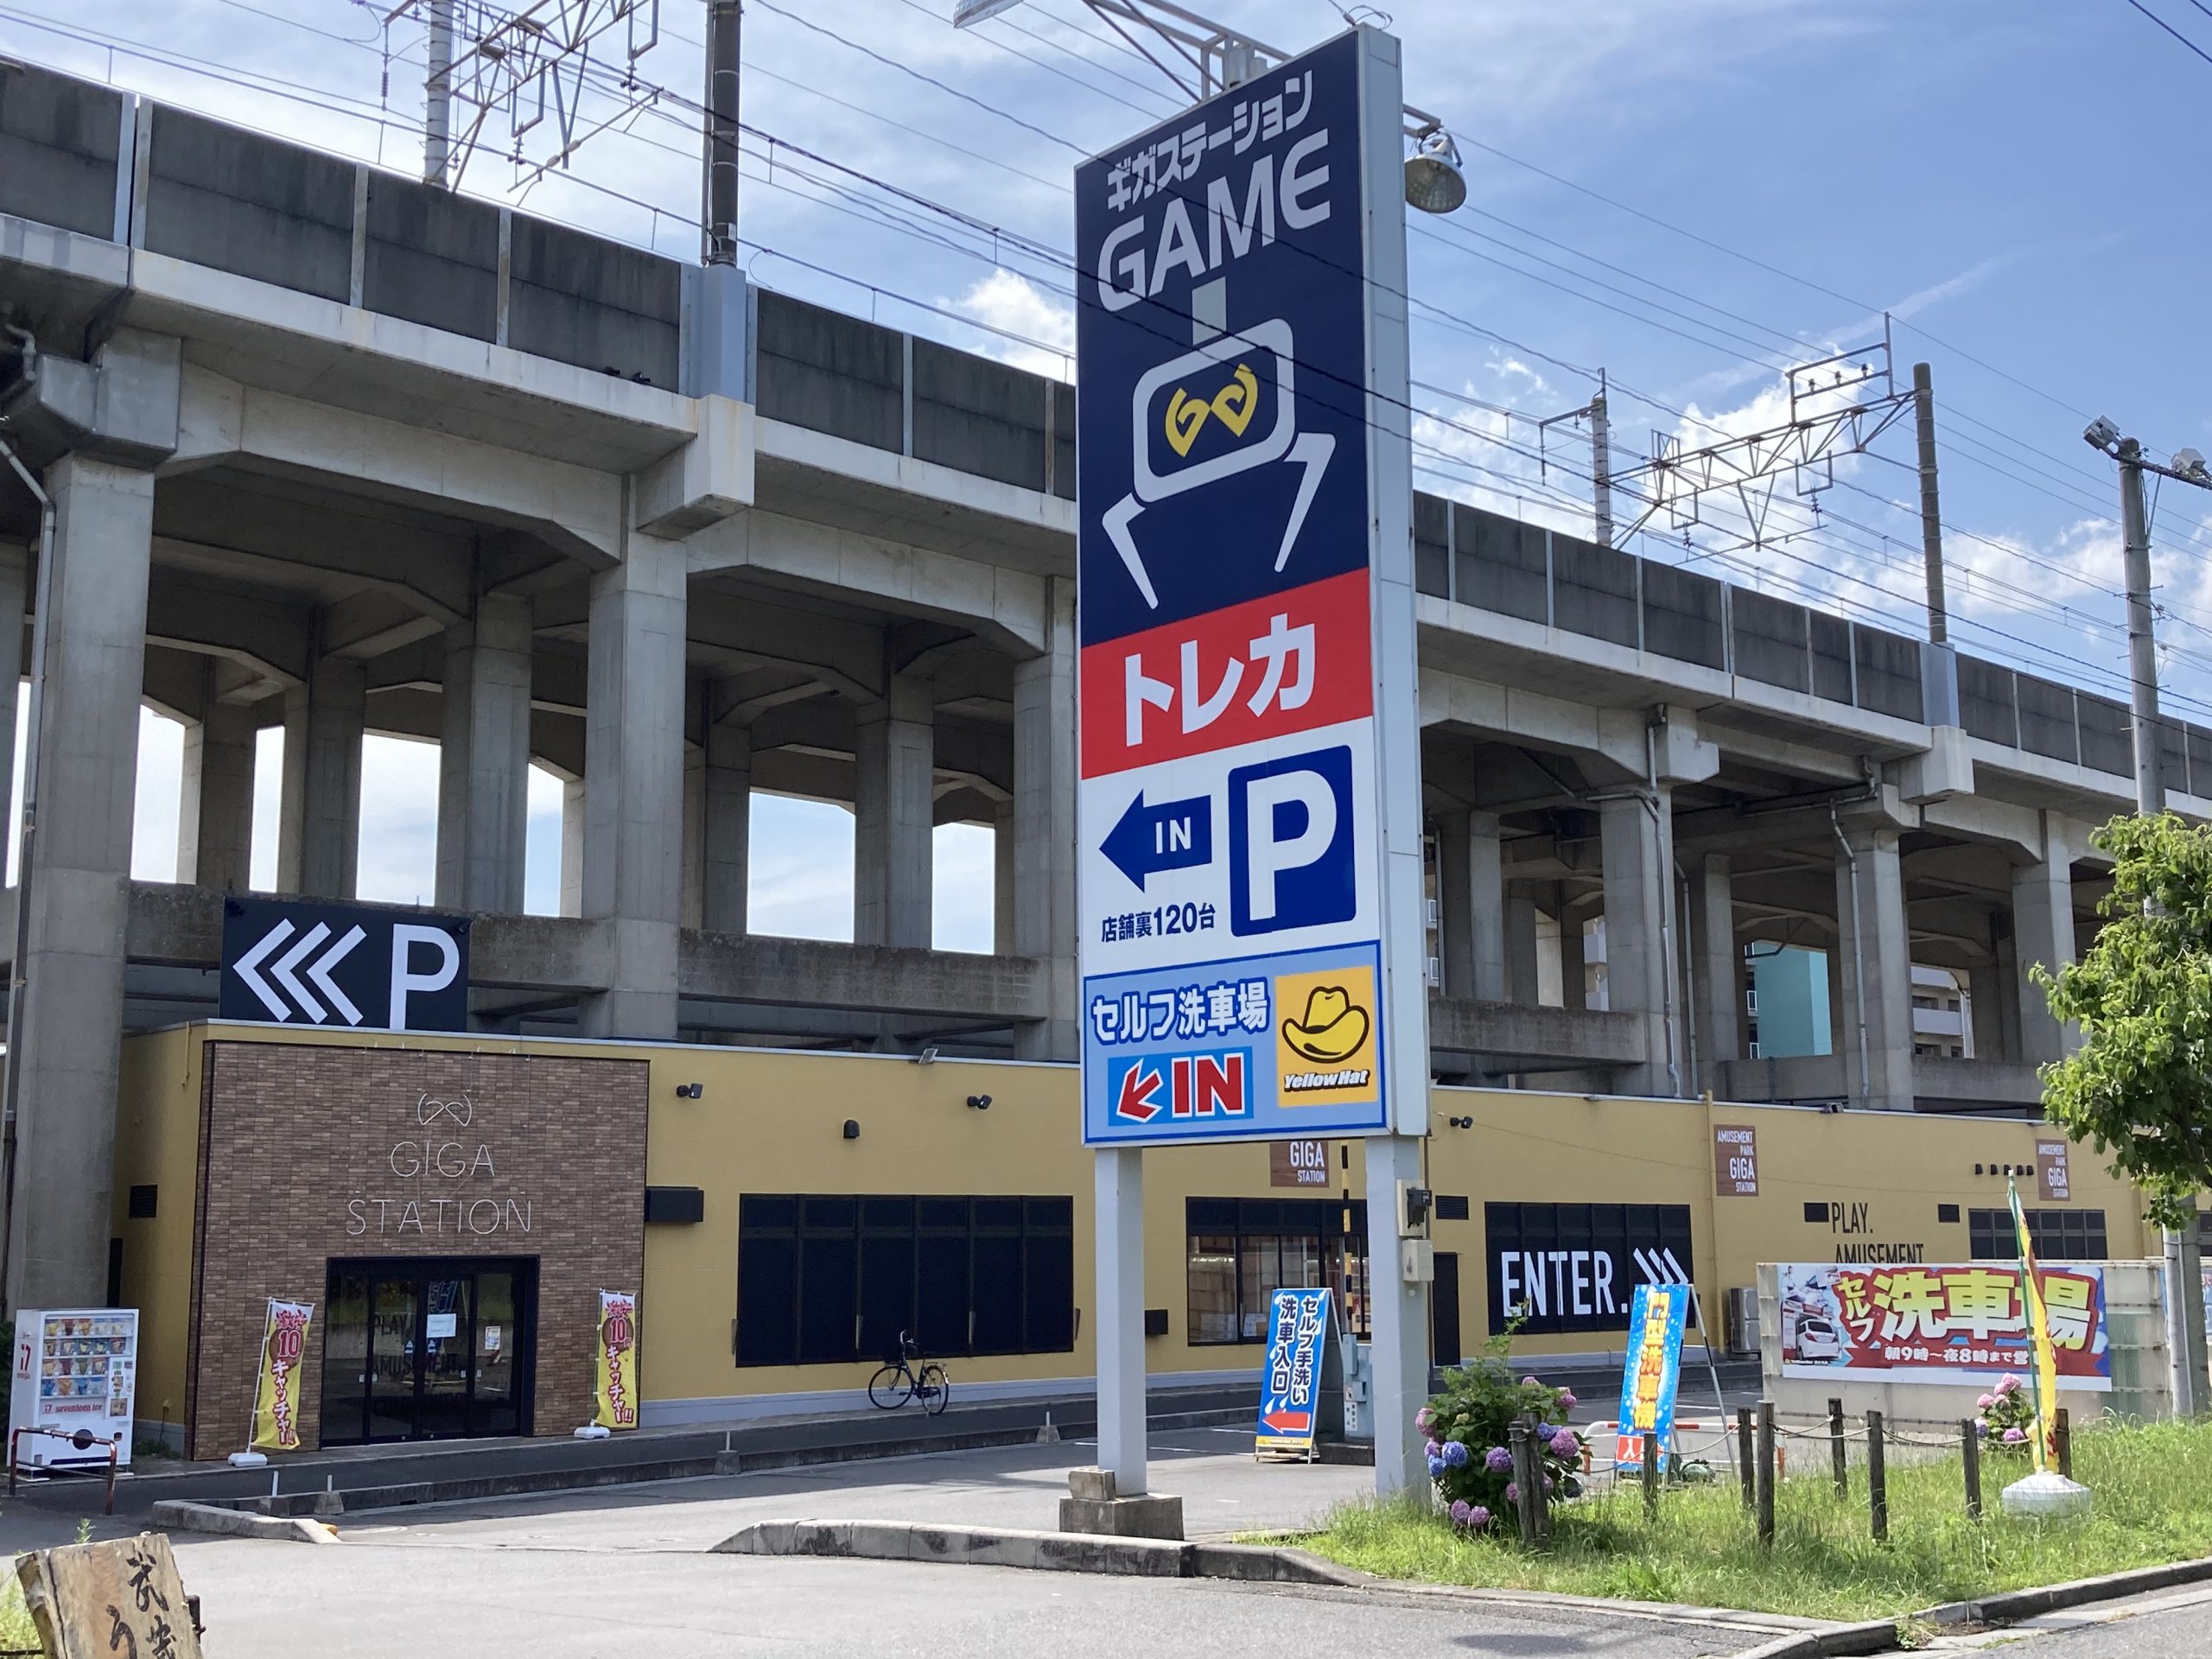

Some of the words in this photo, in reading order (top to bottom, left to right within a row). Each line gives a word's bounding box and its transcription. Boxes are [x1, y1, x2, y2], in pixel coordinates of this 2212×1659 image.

[1107, 69, 1313, 213] ギガステーション
[1097, 128, 1332, 312] GAME
[1124, 613, 1316, 747] トレカ
[1154, 816, 1192, 855] IN
[1247, 770, 1338, 922] P
[1101, 902, 1217, 943] 店舗裏120台
[389, 922, 461, 1030] P
[1092, 978, 1269, 1044] セルフ洗車場
[1171, 1052, 1247, 1119] IN
[1289, 1141, 1325, 1167] GIGA
[1717, 1129, 1753, 1144] AMUSEMENT
[1739, 1144, 1754, 1156] PARK
[391, 1141, 495, 1178] GIGA
[1297, 1169, 1325, 1183] STATION
[1729, 1157, 1756, 1180] GIGA
[2048, 1167, 2068, 1187] GIGA
[1735, 1181, 1757, 1192] STATION
[346, 1198, 531, 1236] STATION
[1831, 1202, 1873, 1234] PLAY.
[1835, 1243, 1924, 1263] AMUSEMENT
[1501, 1250, 1629, 1317] ENTER.
[1837, 1275, 1875, 1342] セルフ
[1873, 1269, 2091, 1351] 洗車場
[1271, 1295, 1298, 1395] 洗車入口
[1291, 1295, 1319, 1405] セルフ手洗い
[55, 1404, 91, 1414] seventeen
